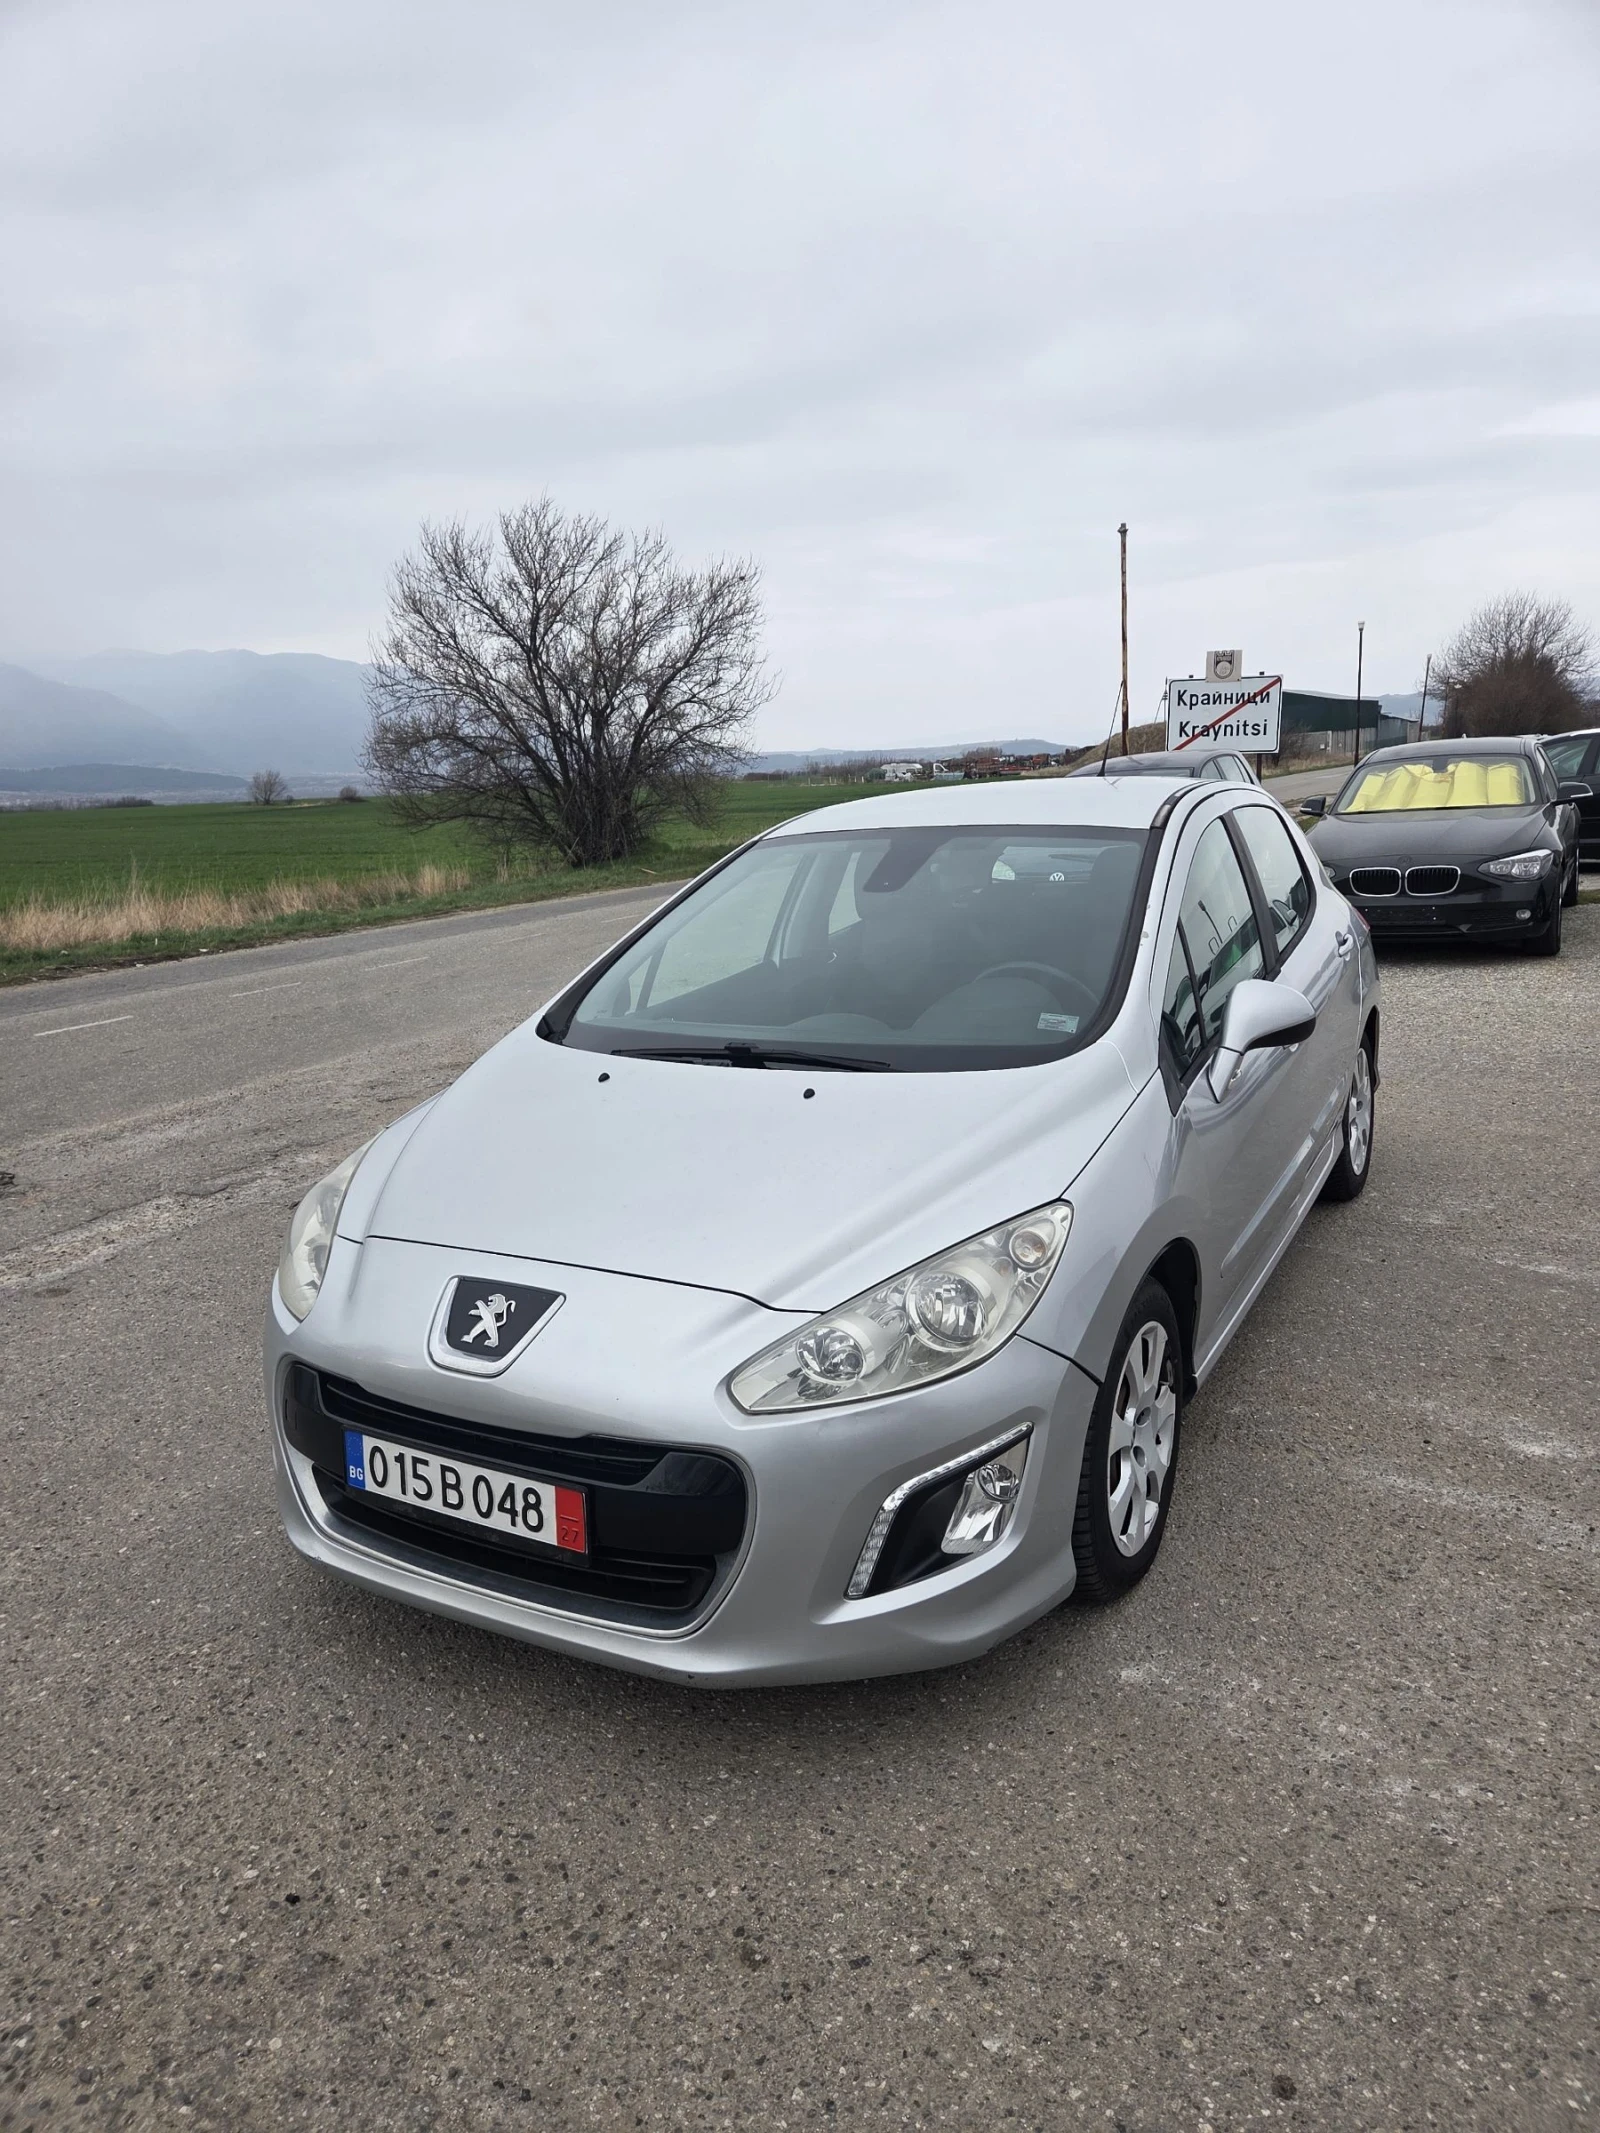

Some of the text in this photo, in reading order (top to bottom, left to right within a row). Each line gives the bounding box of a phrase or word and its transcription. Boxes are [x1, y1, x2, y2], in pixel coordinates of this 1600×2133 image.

[1177, 689, 1271, 710] Крайници
[1179, 719, 1268, 741] Kraynitsi
[349, 1465, 364, 1481] BG
[561, 1525, 579, 1543] 27
